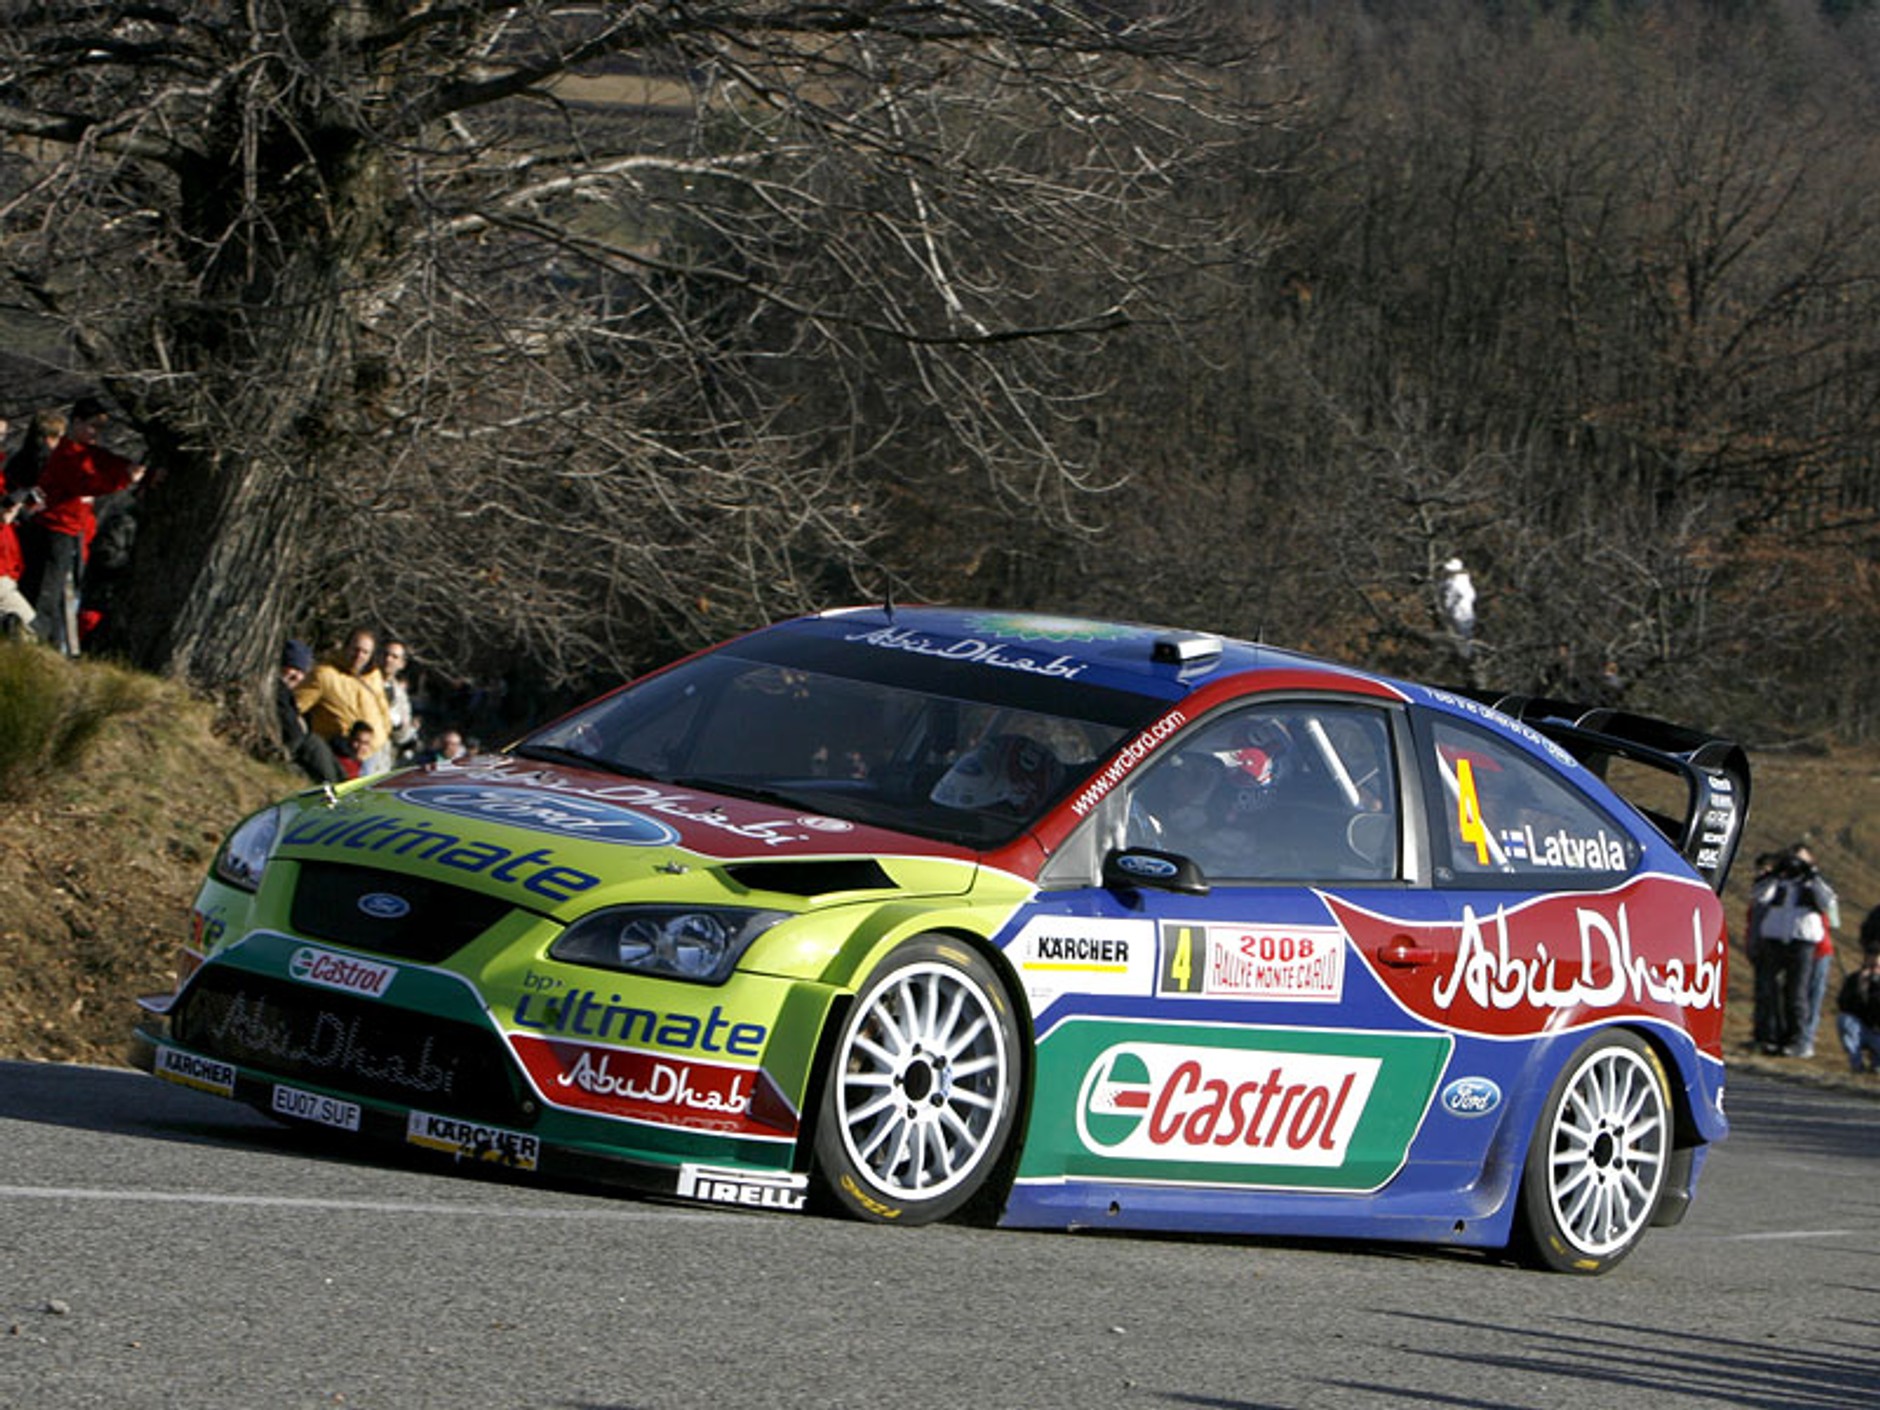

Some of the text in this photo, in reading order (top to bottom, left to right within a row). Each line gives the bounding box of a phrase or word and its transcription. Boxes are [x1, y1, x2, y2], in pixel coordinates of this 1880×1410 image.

[1456, 758, 1490, 866] 4
[281, 814, 602, 902] ultimate
[1525, 824, 1628, 871] Latvala
[309, 954, 389, 993] Castrol
[1170, 927, 1192, 992] 4
[1212, 942, 1337, 990] RALLYE MONTE CARLO
[1240, 935, 1315, 962] 2008
[512, 988, 768, 1057] ultimate
[321, 1100, 358, 1126] SUF
[1148, 1060, 1357, 1150] Castrol
